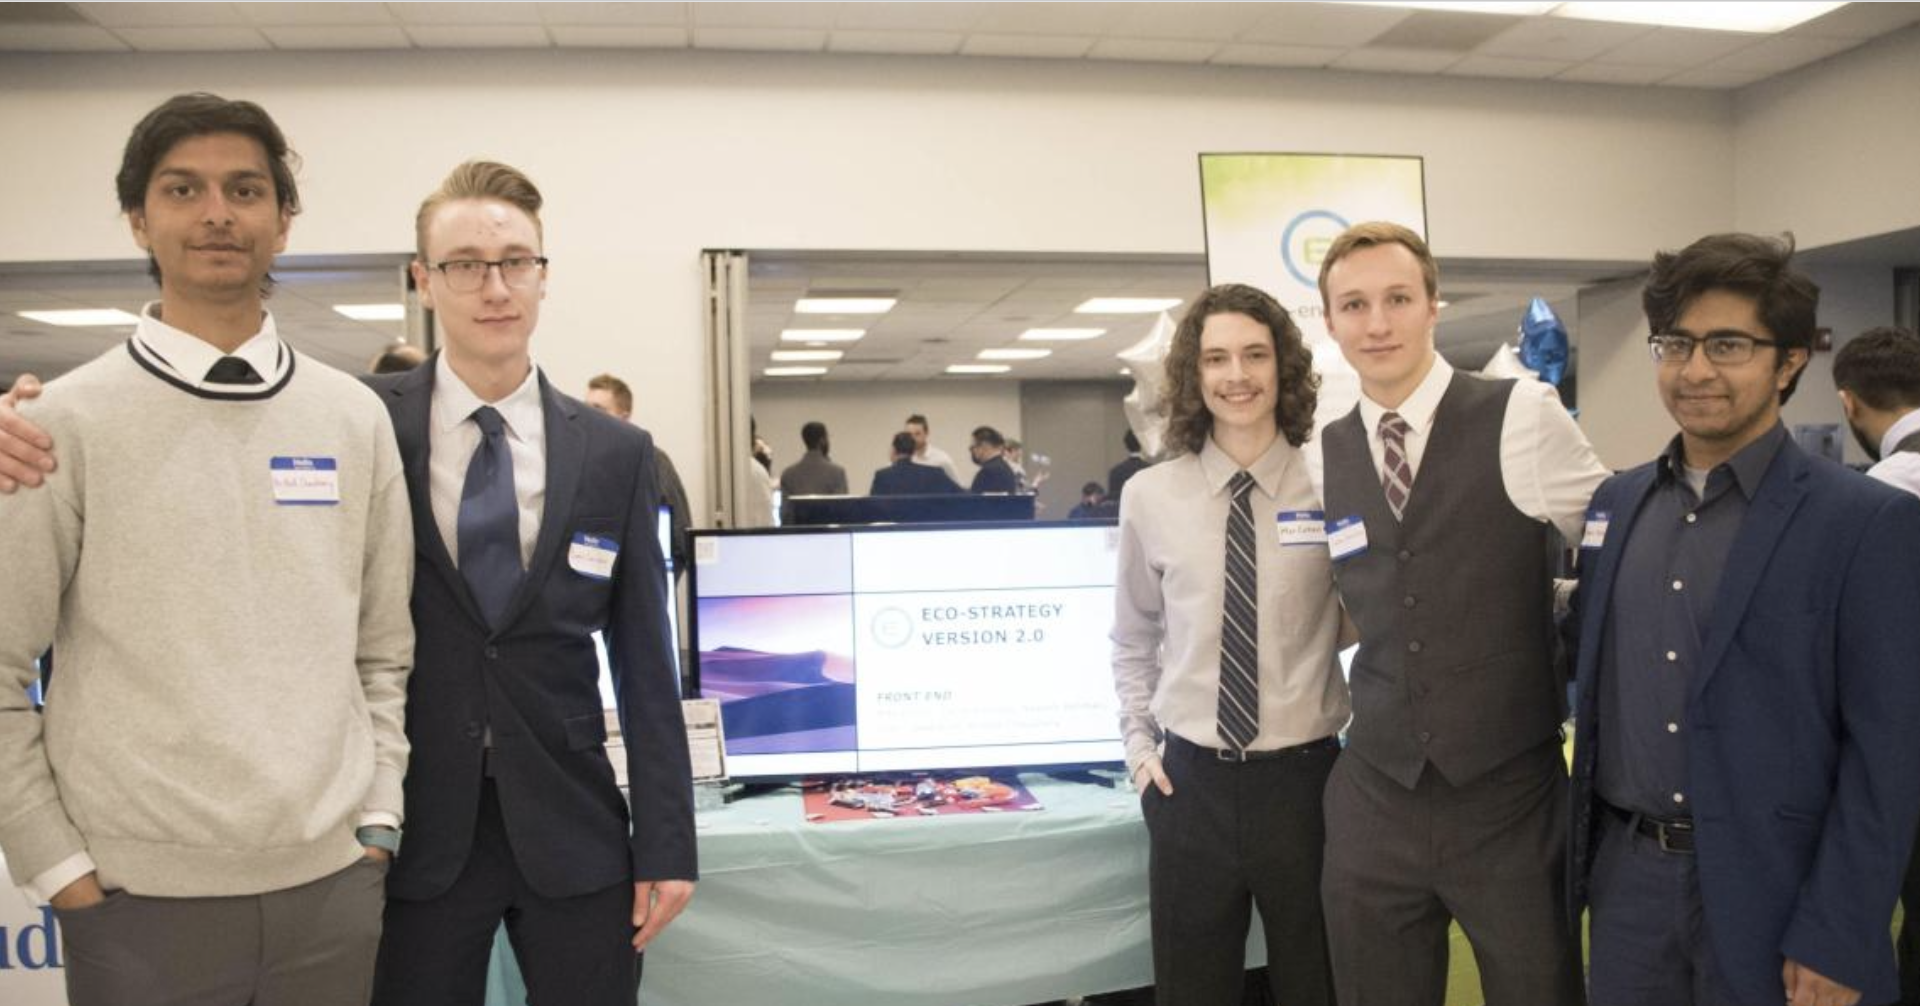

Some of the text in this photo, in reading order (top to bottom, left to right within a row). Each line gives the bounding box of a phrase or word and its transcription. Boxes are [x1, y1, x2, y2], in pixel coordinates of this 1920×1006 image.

[922, 604, 1063, 621] ECO-STRATEGY
[922, 628, 1045, 646] VERSION 2.0
[877, 690, 953, 702] FRONT END
